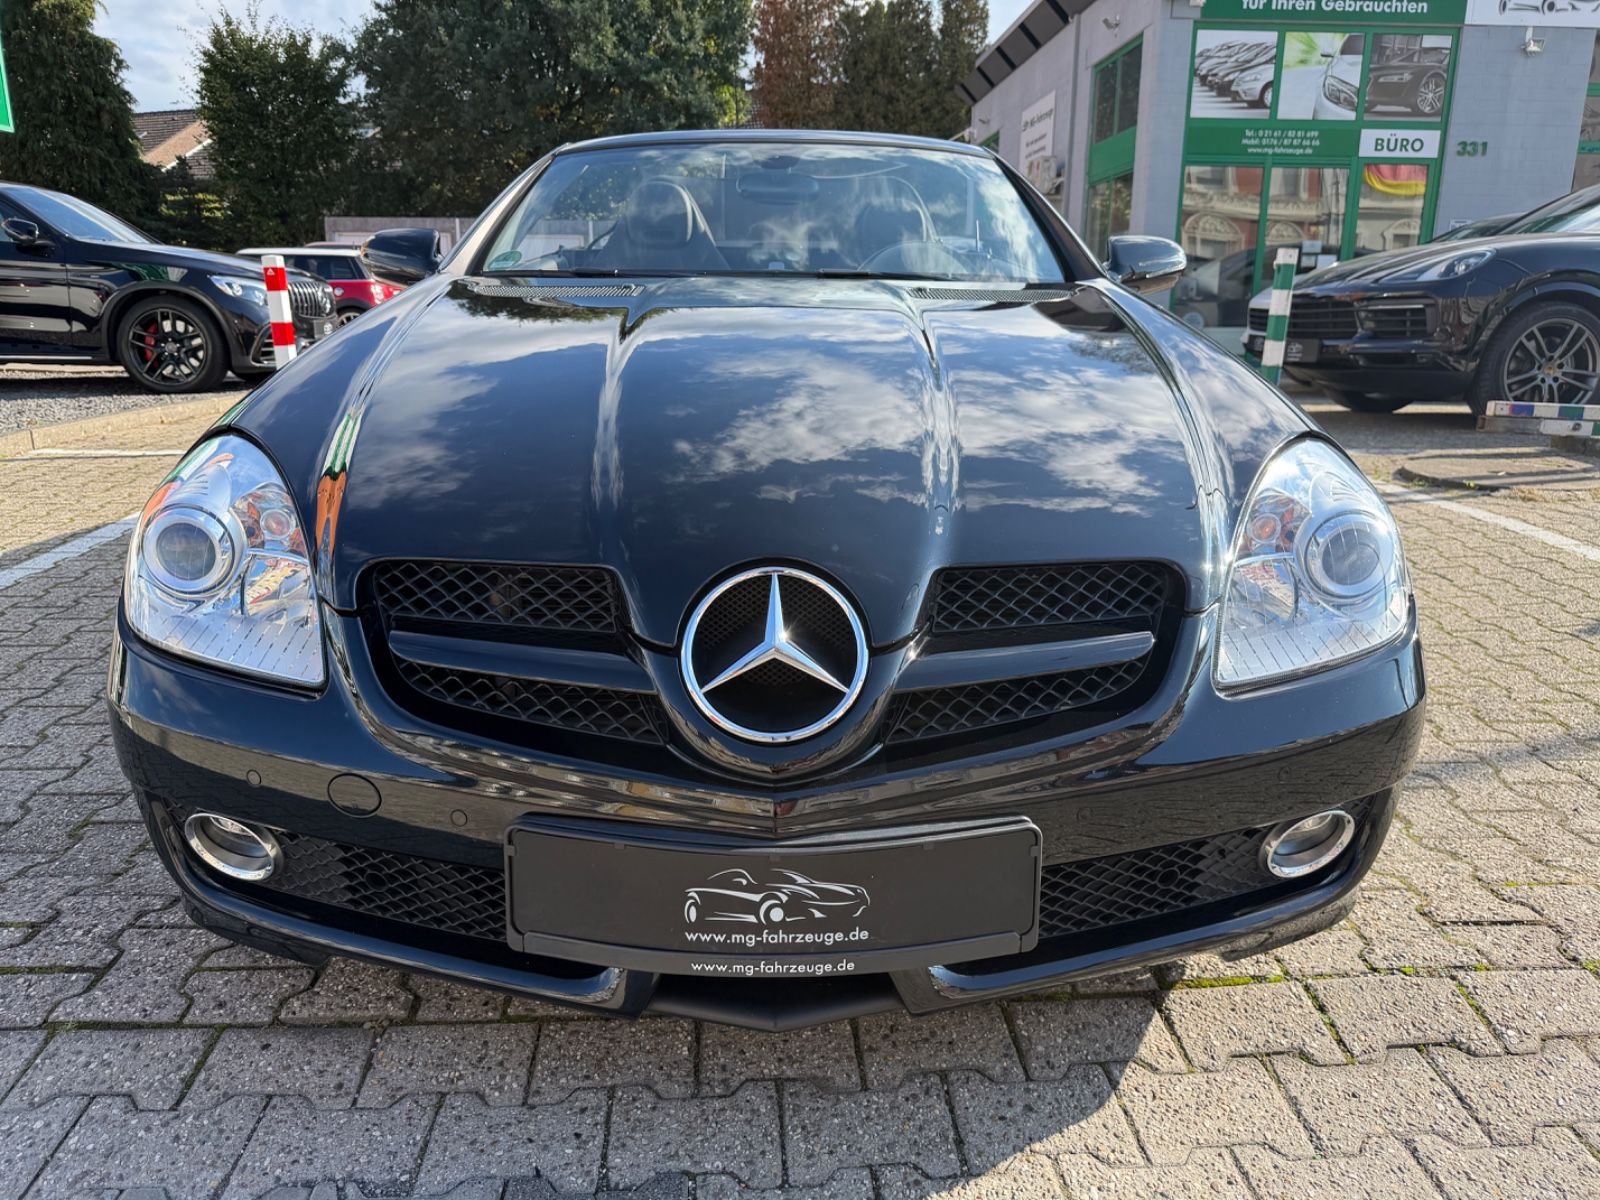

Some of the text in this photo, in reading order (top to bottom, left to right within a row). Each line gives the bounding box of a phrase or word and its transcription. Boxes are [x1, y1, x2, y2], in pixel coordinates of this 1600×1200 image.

[1272, 0, 1315, 11] Ihren
[1321, 0, 1428, 13] Gebrauchten
[1374, 133, 1425, 152] BÜRO
[1456, 141, 1488, 157] 331
[685, 926, 869, 947] www.mg-fahrzeuge.de
[691, 959, 855, 976] www.mg-fahrzeuge.de
